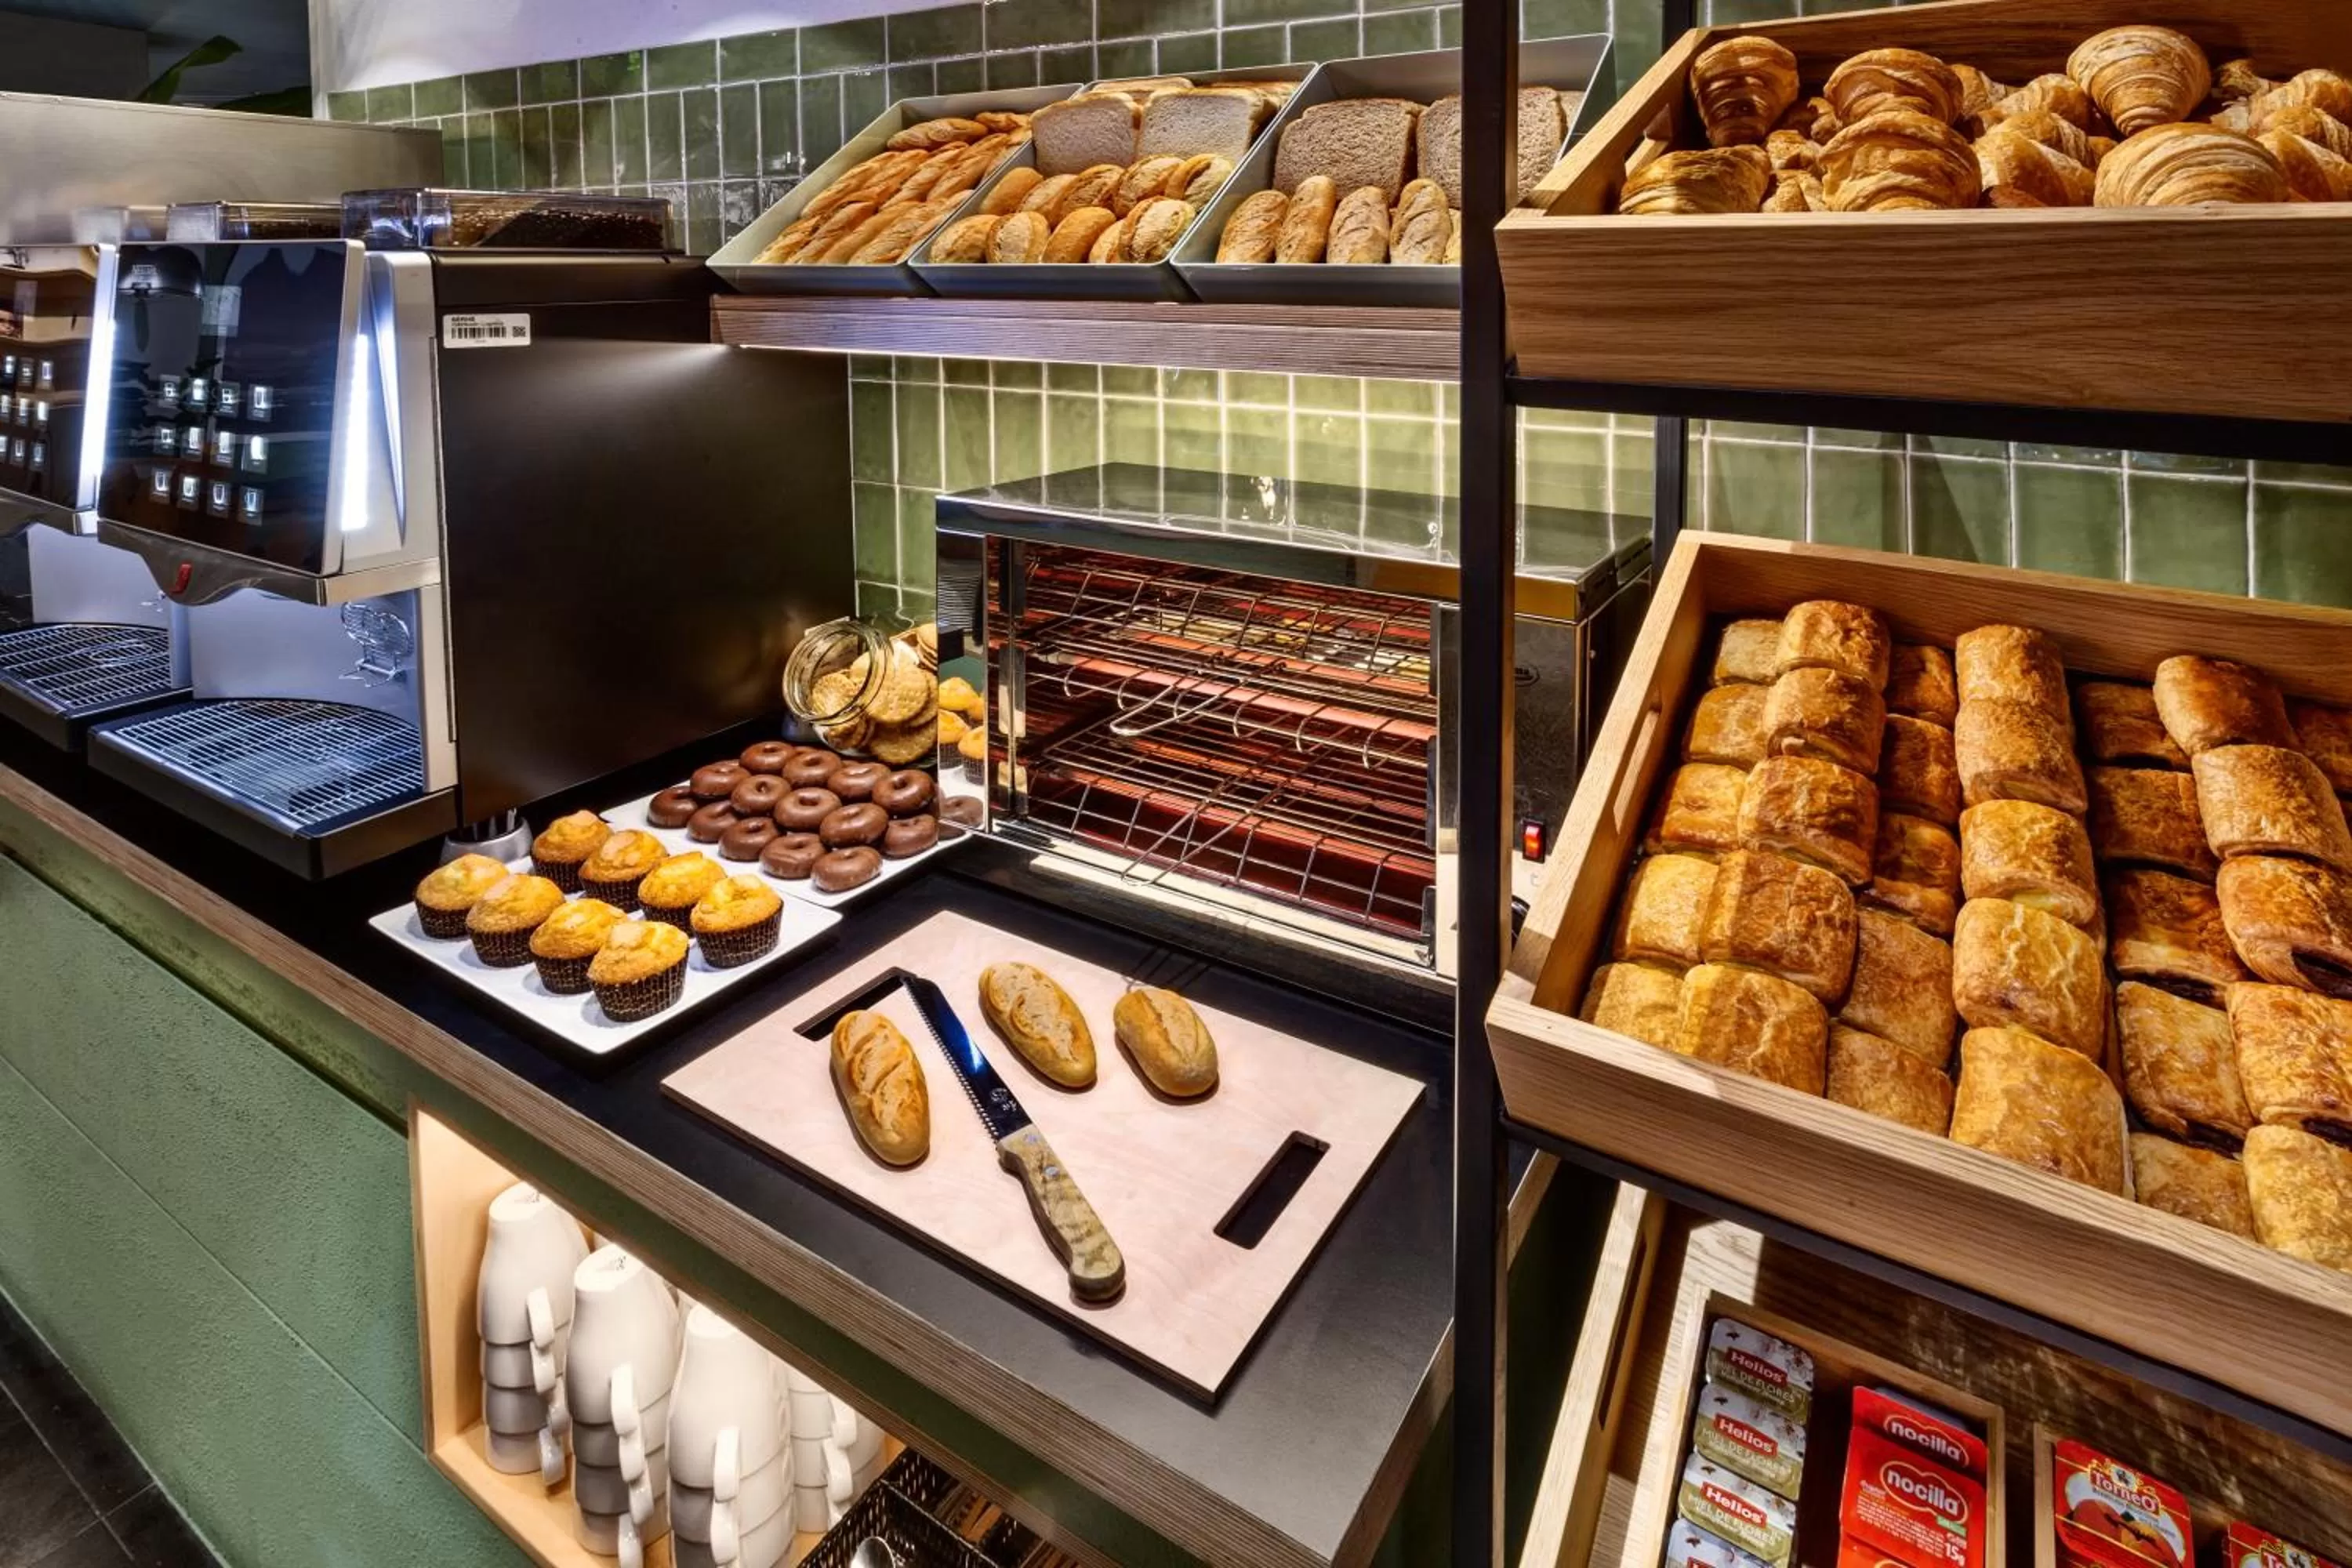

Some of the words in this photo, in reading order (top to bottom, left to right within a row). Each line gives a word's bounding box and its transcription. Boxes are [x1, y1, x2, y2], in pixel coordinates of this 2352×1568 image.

[1730, 1351, 1783, 1383] Helios
[1719, 1418, 1773, 1453] Helios
[1891, 1421, 1960, 1461] nocilla
[1706, 1486, 1763, 1524] Helios
[1887, 1469, 1958, 1516] nocilla
